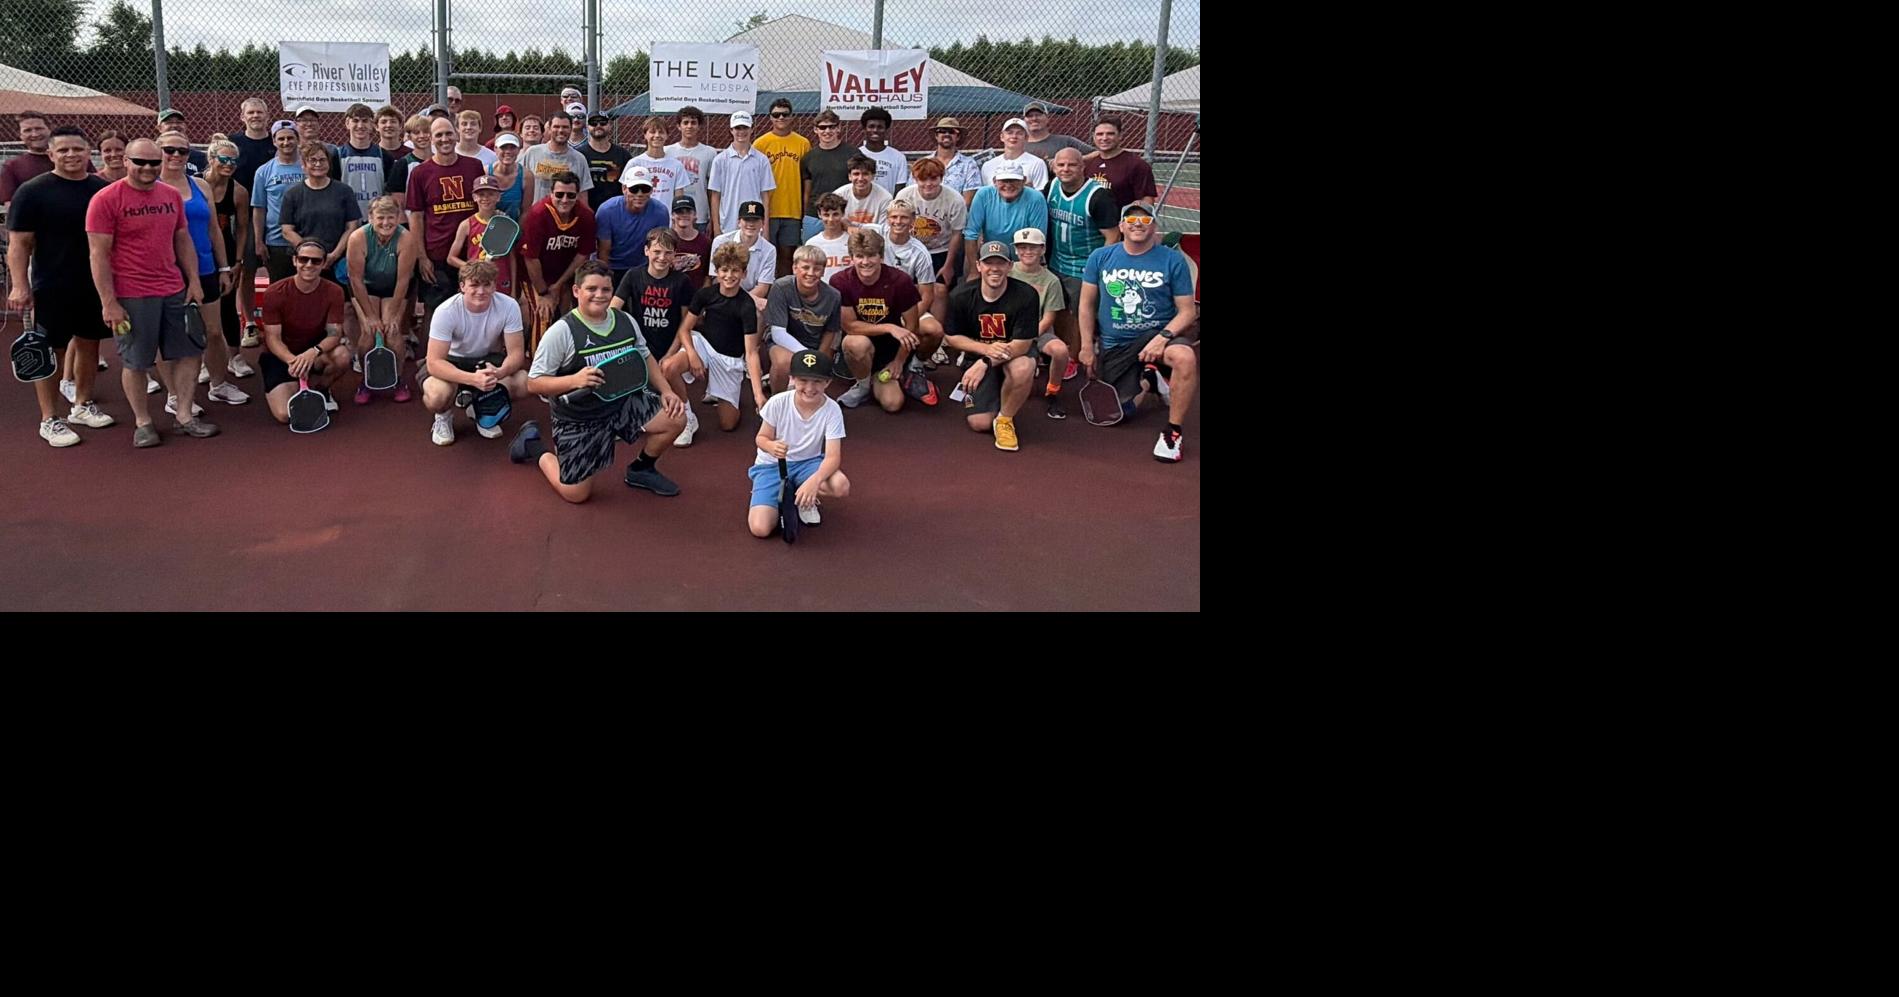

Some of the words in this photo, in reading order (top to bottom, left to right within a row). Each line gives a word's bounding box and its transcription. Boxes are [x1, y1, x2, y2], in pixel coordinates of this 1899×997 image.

[312, 62, 344, 80] River
[349, 63, 387, 84] Valley
[653, 60, 698, 78] THE
[710, 61, 755, 81] LUX
[826, 59, 927, 94] VALLEY
[288, 81, 303, 91] EYE
[307, 81, 380, 92] PROFESSIONALS
[700, 82, 750, 93] MEDSPA
[828, 94, 923, 103] AUTOHAUS
[767, 145, 800, 165] Gophers
[348, 162, 377, 173] CHINO
[648, 167, 675, 179] EGUARD
[439, 175, 464, 201] N
[355, 190, 378, 201] ILLS
[123, 204, 164, 217] Hurley
[1060, 221, 1068, 243] 1
[1102, 268, 1164, 288] WOLVES
[644, 285, 669, 298] ANY
[643, 307, 669, 318] ANY
[978, 313, 1007, 339] N
